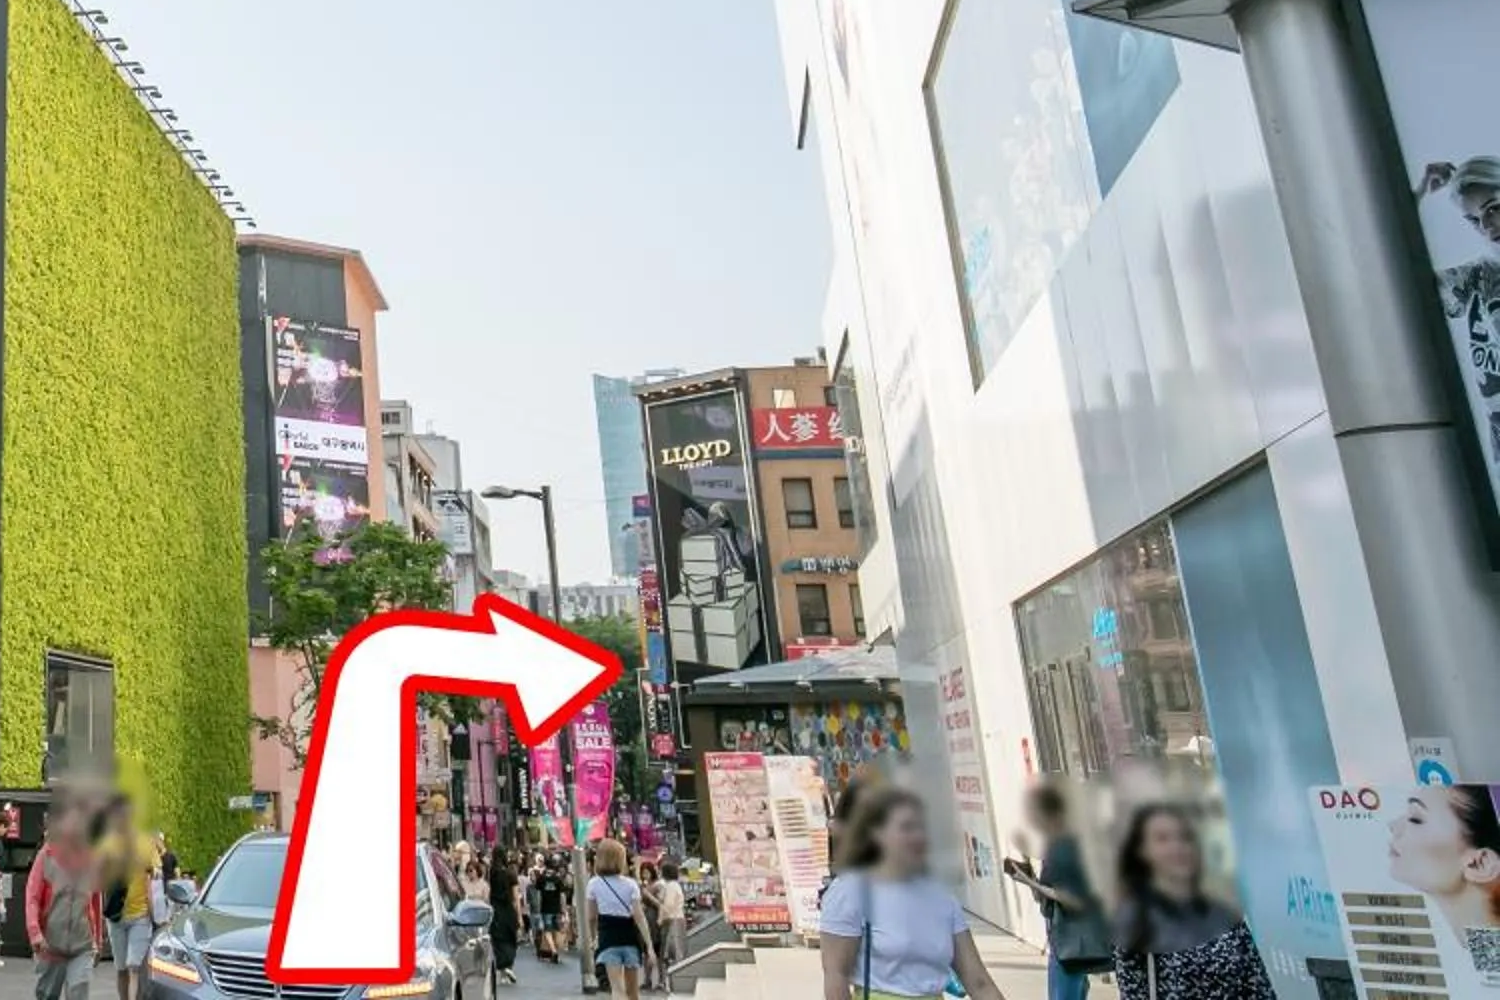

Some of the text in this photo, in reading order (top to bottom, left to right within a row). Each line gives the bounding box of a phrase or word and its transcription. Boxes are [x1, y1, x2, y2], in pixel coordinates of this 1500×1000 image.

[660, 438, 731, 466] LLOYD
[576, 737, 611, 749] SALE
[1320, 788, 1381, 811] DAO
